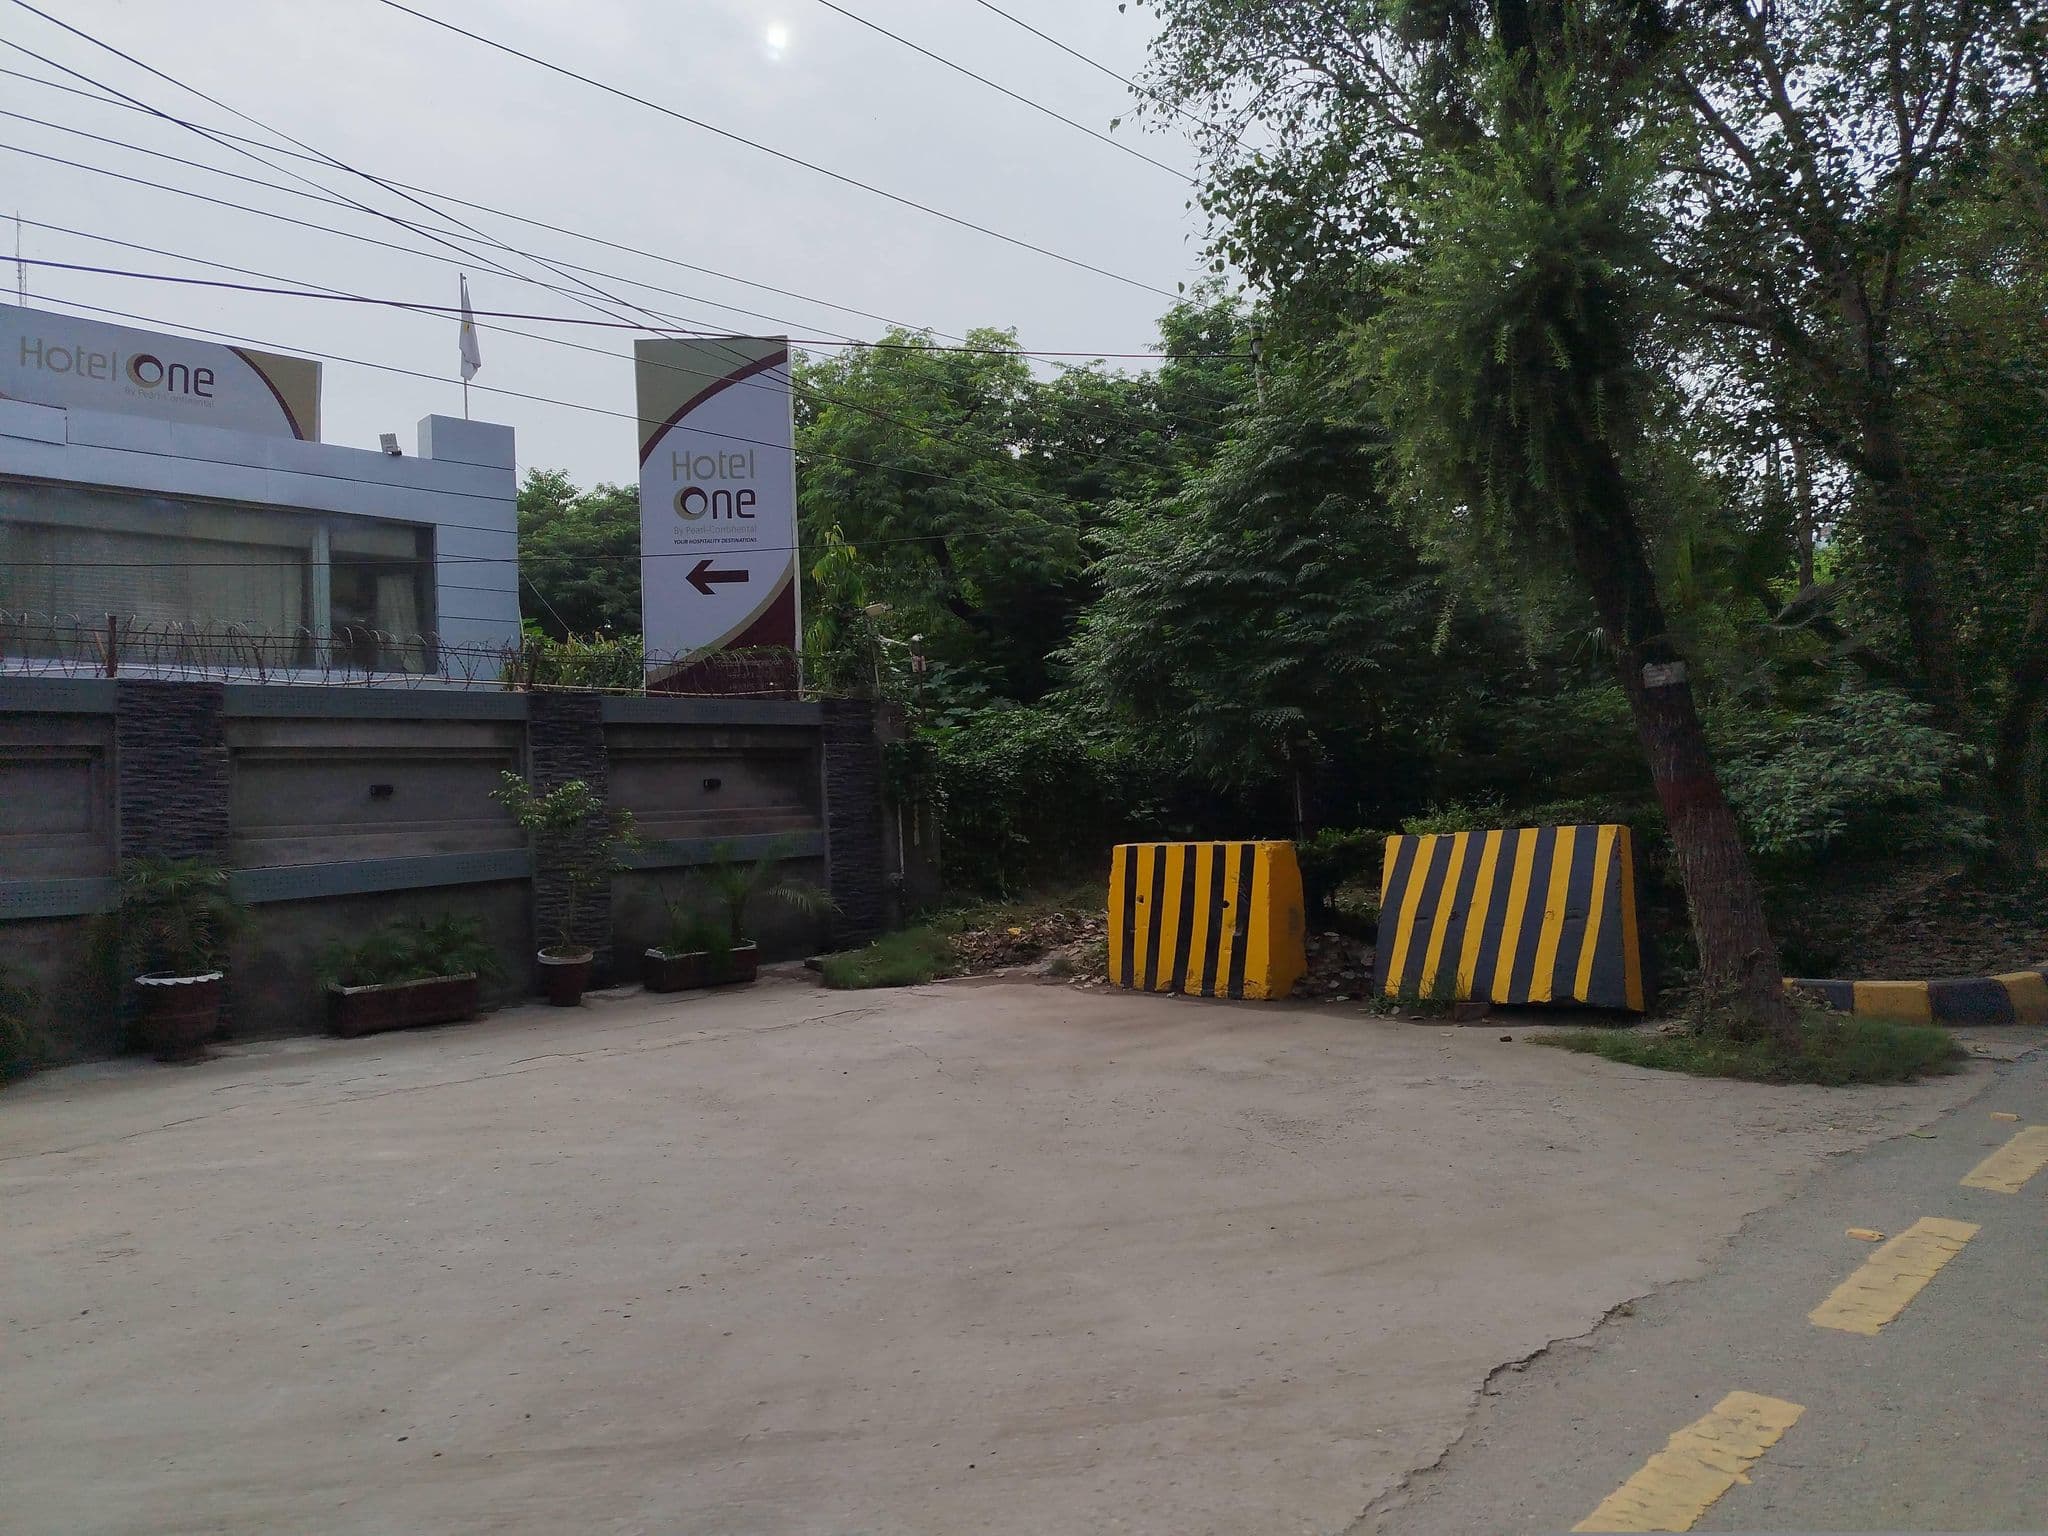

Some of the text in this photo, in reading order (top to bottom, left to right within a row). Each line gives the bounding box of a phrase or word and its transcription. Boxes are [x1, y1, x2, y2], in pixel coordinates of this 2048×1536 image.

[19, 334, 215, 398] Hotel One
[672, 448, 754, 481] Hotel
[673, 486, 756, 521] One
[673, 526, 684, 537] By
